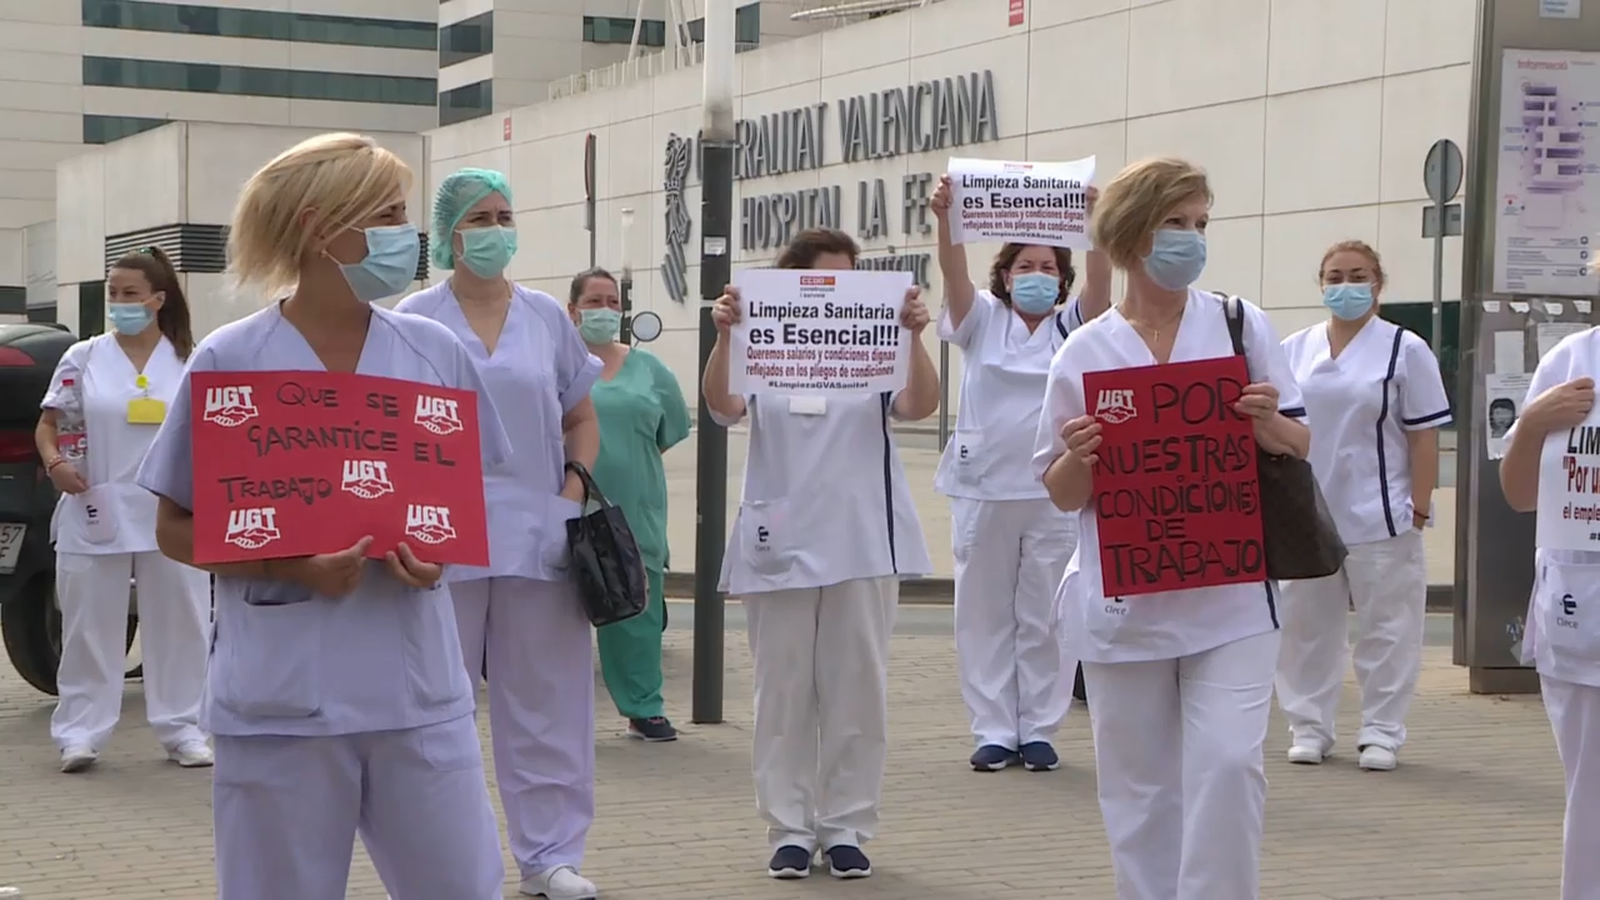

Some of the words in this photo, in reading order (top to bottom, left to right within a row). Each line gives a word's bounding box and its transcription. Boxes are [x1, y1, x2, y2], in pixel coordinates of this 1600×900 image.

[697, 102, 828, 181] ERALITAT
[838, 70, 999, 163] VALENCIANA
[962, 174, 1019, 192] Limpieza
[1023, 176, 1081, 189] Sanitaria
[740, 185, 841, 250] HOSPITAL
[857, 178, 888, 240] LA
[902, 172, 932, 235] FE
[963, 195, 984, 209] es
[990, 193, 1086, 210] Esencial!!!
[962, 210, 993, 219] Queremos
[1004, 220, 1014, 230] los
[1039, 221, 1046, 230] de
[749, 301, 819, 322] Limpieza
[824, 302, 894, 320] Sanitaria
[749, 327, 775, 344] es
[783, 324, 899, 346] Esencial!!!
[746, 346, 785, 360] Queremos
[786, 346, 816, 360] salarios
[817, 350, 823, 364] y
[824, 348, 870, 361] condiciones
[871, 348, 896, 364] dignas
[746, 364, 783, 379] reflejados
[785, 366, 796, 376] en
[796, 364, 808, 376] los
[809, 363, 837, 380] pliegos
[839, 364, 849, 376] de
[850, 365, 894, 378] condiciones
[206, 386, 253, 412] UGT
[277, 382, 339, 407] QUE
[367, 393, 399, 417] SE
[416, 395, 459, 419] UGT
[1099, 389, 1135, 410] UGT
[1151, 377, 1247, 425] POR
[414, 442, 456, 466] EL
[1095, 433, 1249, 476] NUESTRAS
[342, 460, 388, 483] UGT
[218, 476, 332, 505] TRABAJO
[227, 507, 277, 532] UGT
[407, 504, 451, 528] UGT
[1563, 501, 1572, 520] el
[1146, 518, 1186, 542] DE
[1104, 539, 1263, 587] TRABAJO
